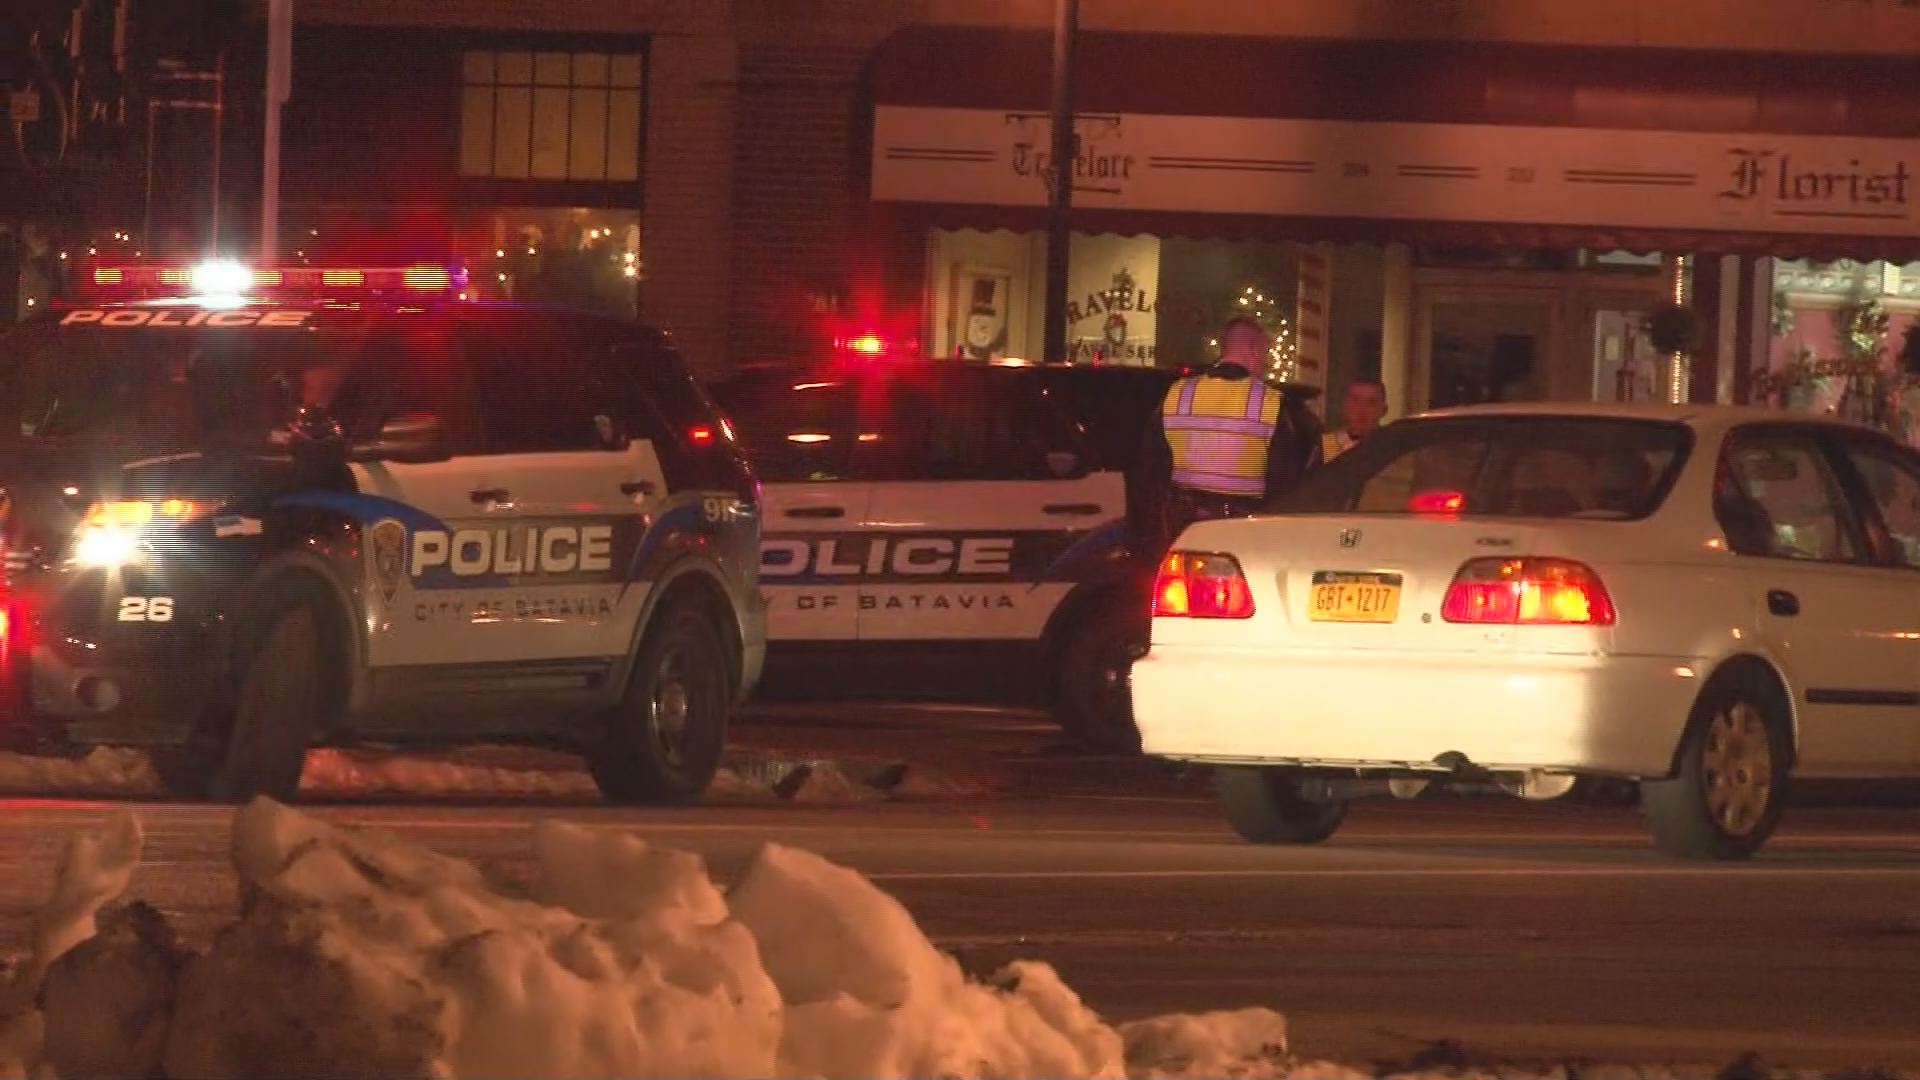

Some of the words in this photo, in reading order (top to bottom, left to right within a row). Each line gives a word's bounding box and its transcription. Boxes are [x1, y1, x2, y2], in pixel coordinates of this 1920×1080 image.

[1716, 149, 1910, 204] Florist
[60, 310, 312, 327] POLICE
[411, 526, 613, 577] POLICE
[759, 537, 1015, 576] OLICE
[117, 596, 175, 622] 26
[413, 602, 464, 621] CITY
[796, 595, 840, 609] OF
[860, 594, 1016, 609] BATAVIA
